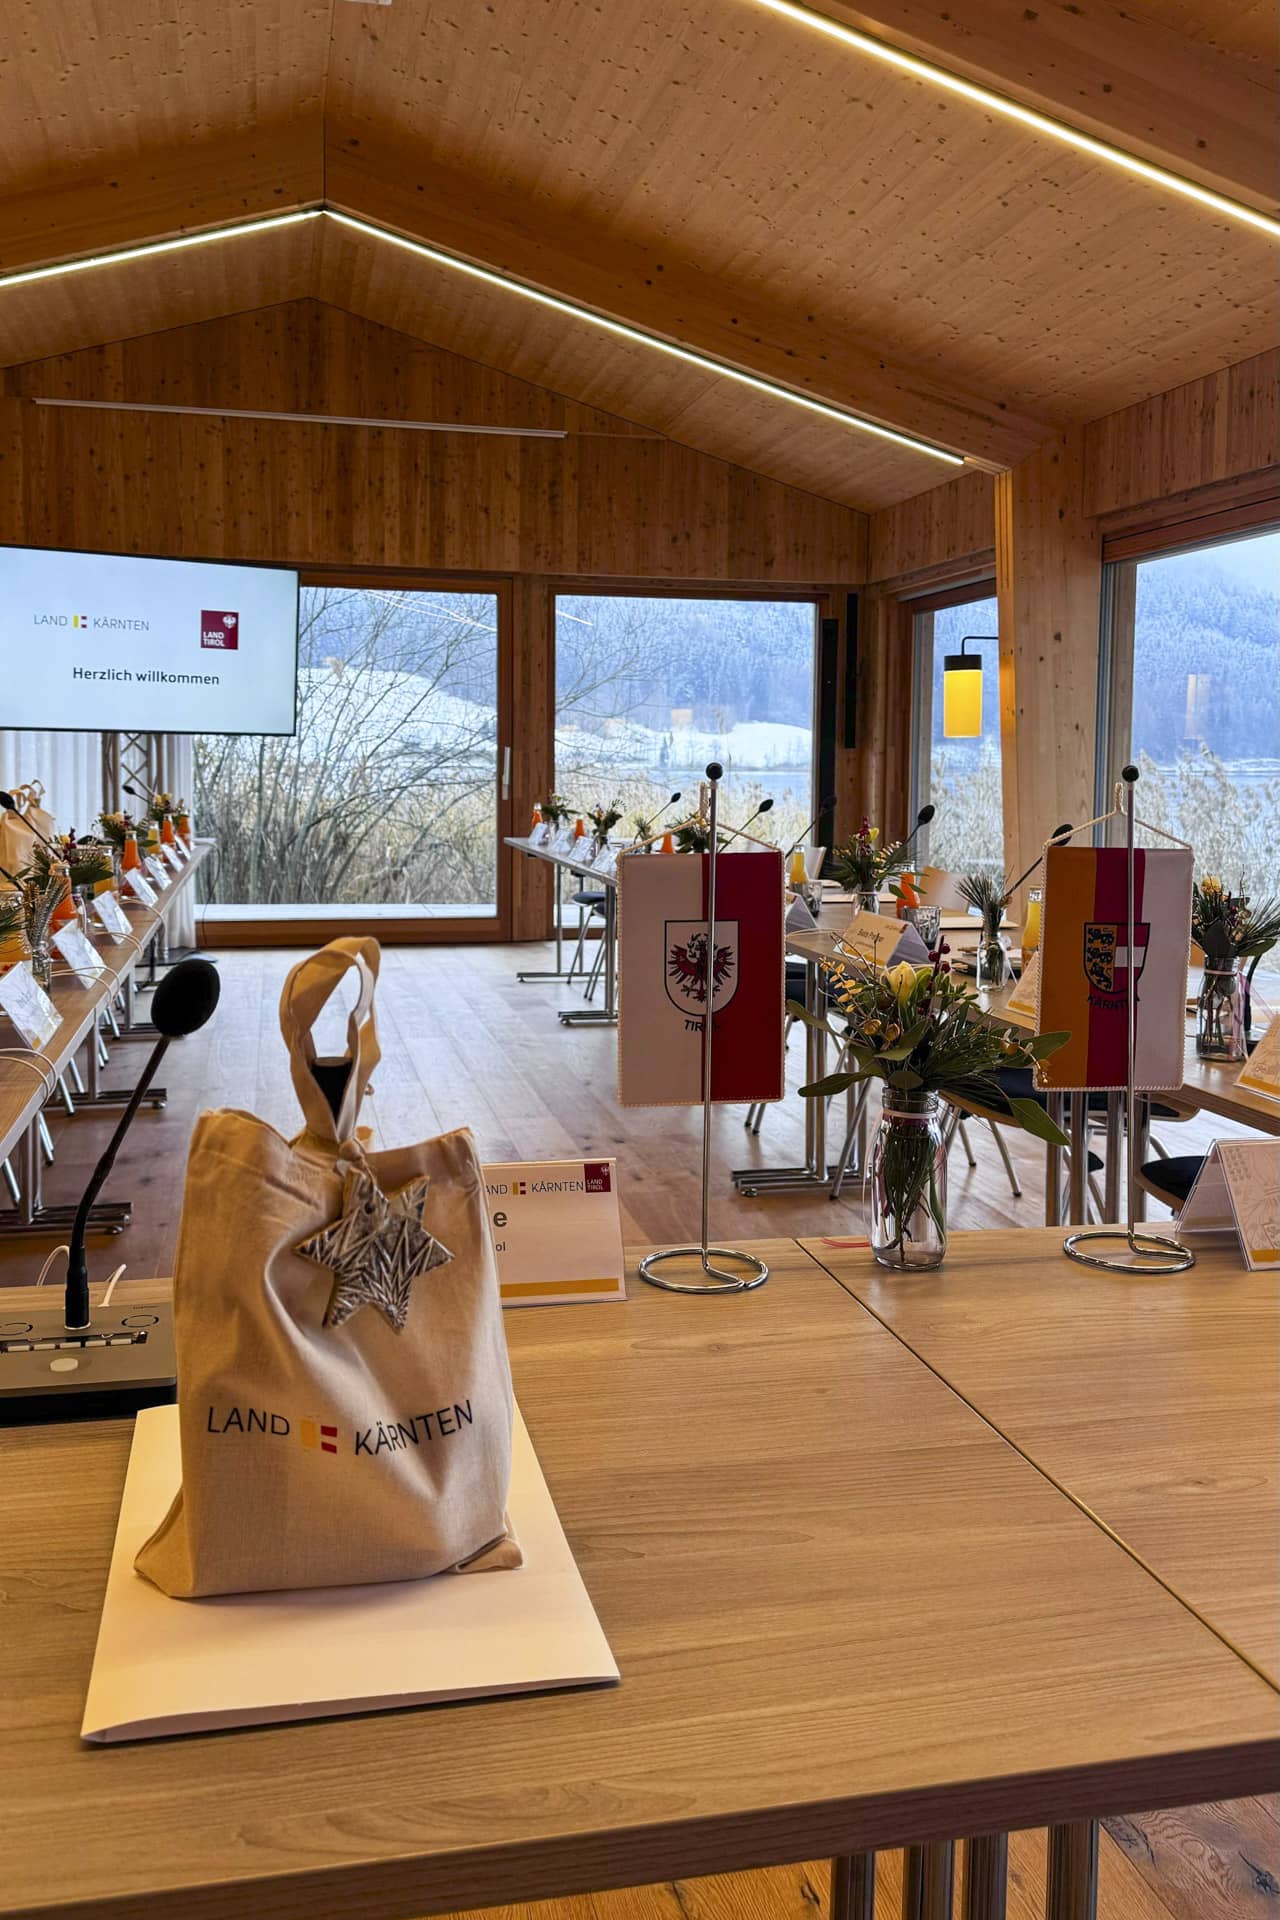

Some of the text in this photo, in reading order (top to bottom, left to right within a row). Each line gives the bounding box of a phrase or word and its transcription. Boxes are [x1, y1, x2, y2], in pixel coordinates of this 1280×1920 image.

[33, 614, 150, 631] LAND KÄRNTEN
[203, 631, 225, 640] LAND
[203, 638, 225, 647] TIROL
[72, 667, 220, 686] Herzlich willkommen
[531, 1180, 584, 1193] KÄRNTEN
[207, 1399, 474, 1456] LAND KÄRNTEN
